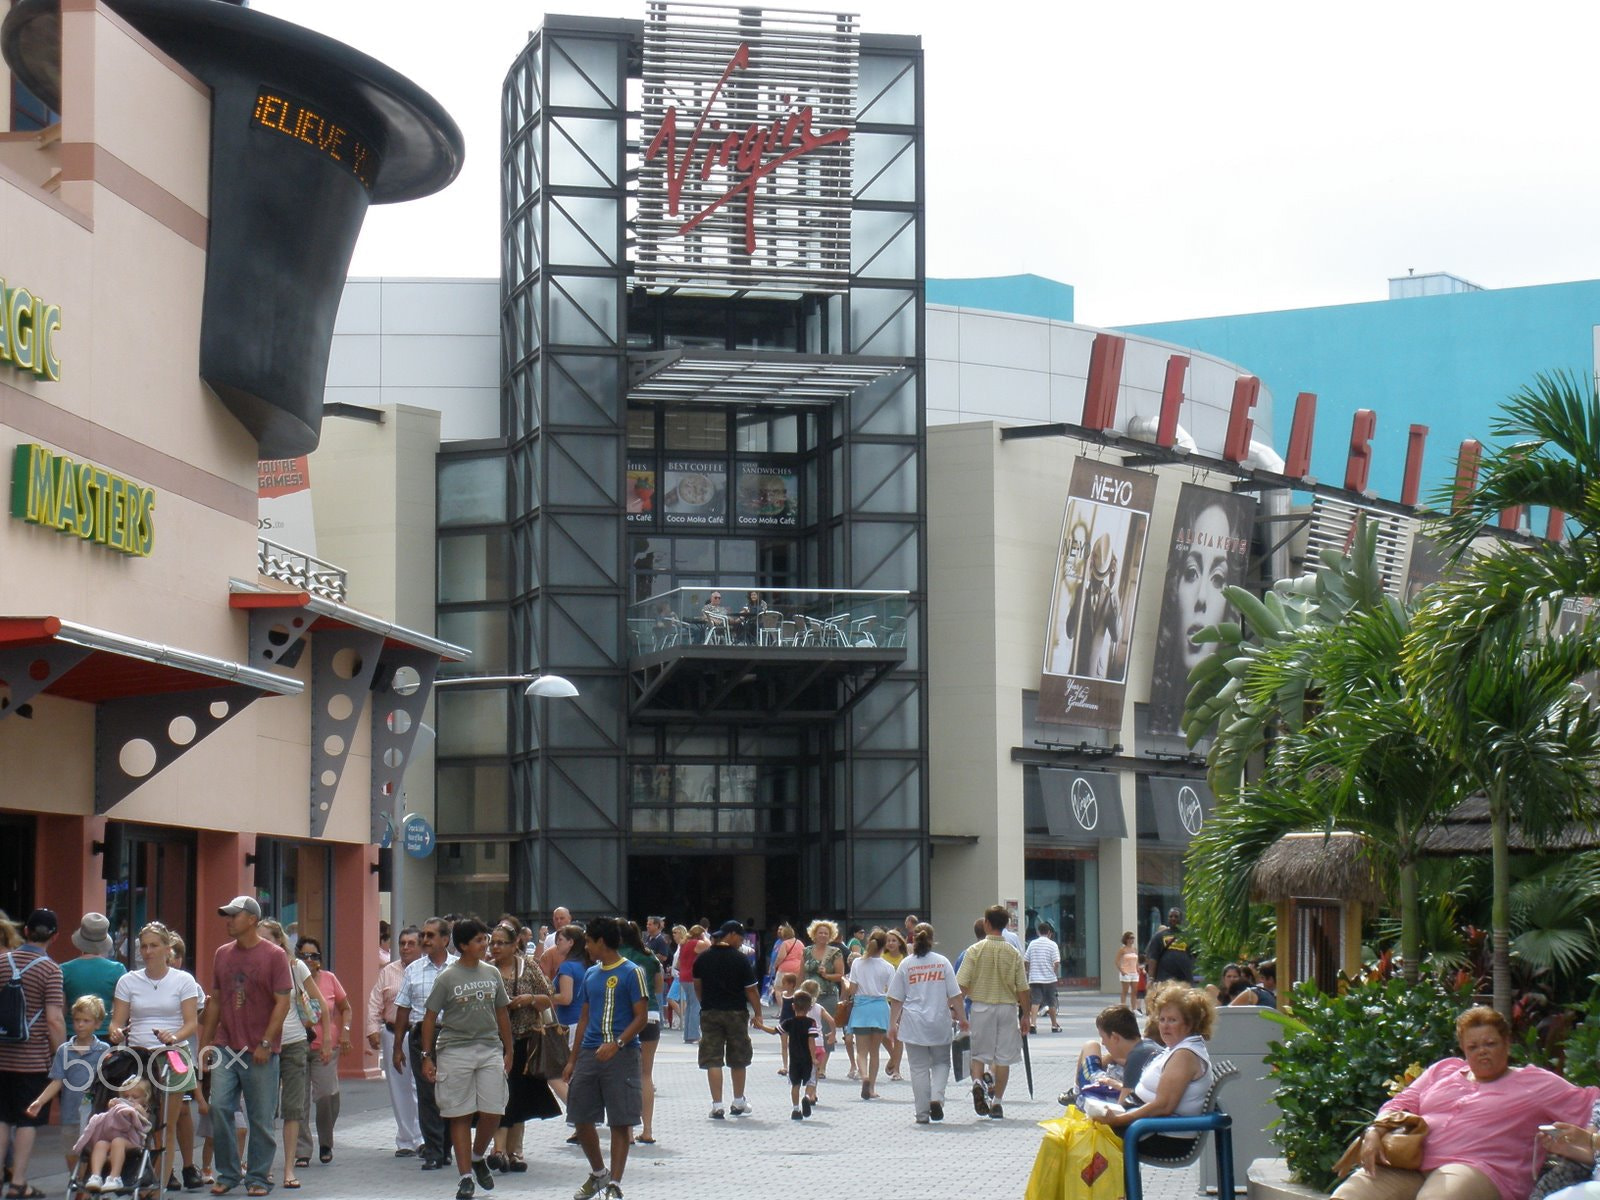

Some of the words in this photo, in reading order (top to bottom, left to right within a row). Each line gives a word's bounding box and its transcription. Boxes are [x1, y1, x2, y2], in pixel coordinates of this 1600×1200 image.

[646, 41, 850, 255] Virgin
[668, 462, 688, 471] BEST
[690, 463, 724, 473] COFFEE
[742, 467, 793, 475] SANDWICHES
[1090, 474, 1134, 507] NE-YO
[15, 443, 156, 559] MASTERS
[666, 515, 686, 523] Coco
[708, 515, 724, 524] Café
[738, 516, 758, 524] Coco
[758, 517, 778, 525] Moka
[779, 517, 796, 525] Café
[908, 971, 945, 984] STIHL
[454, 980, 498, 995] CANCUN
